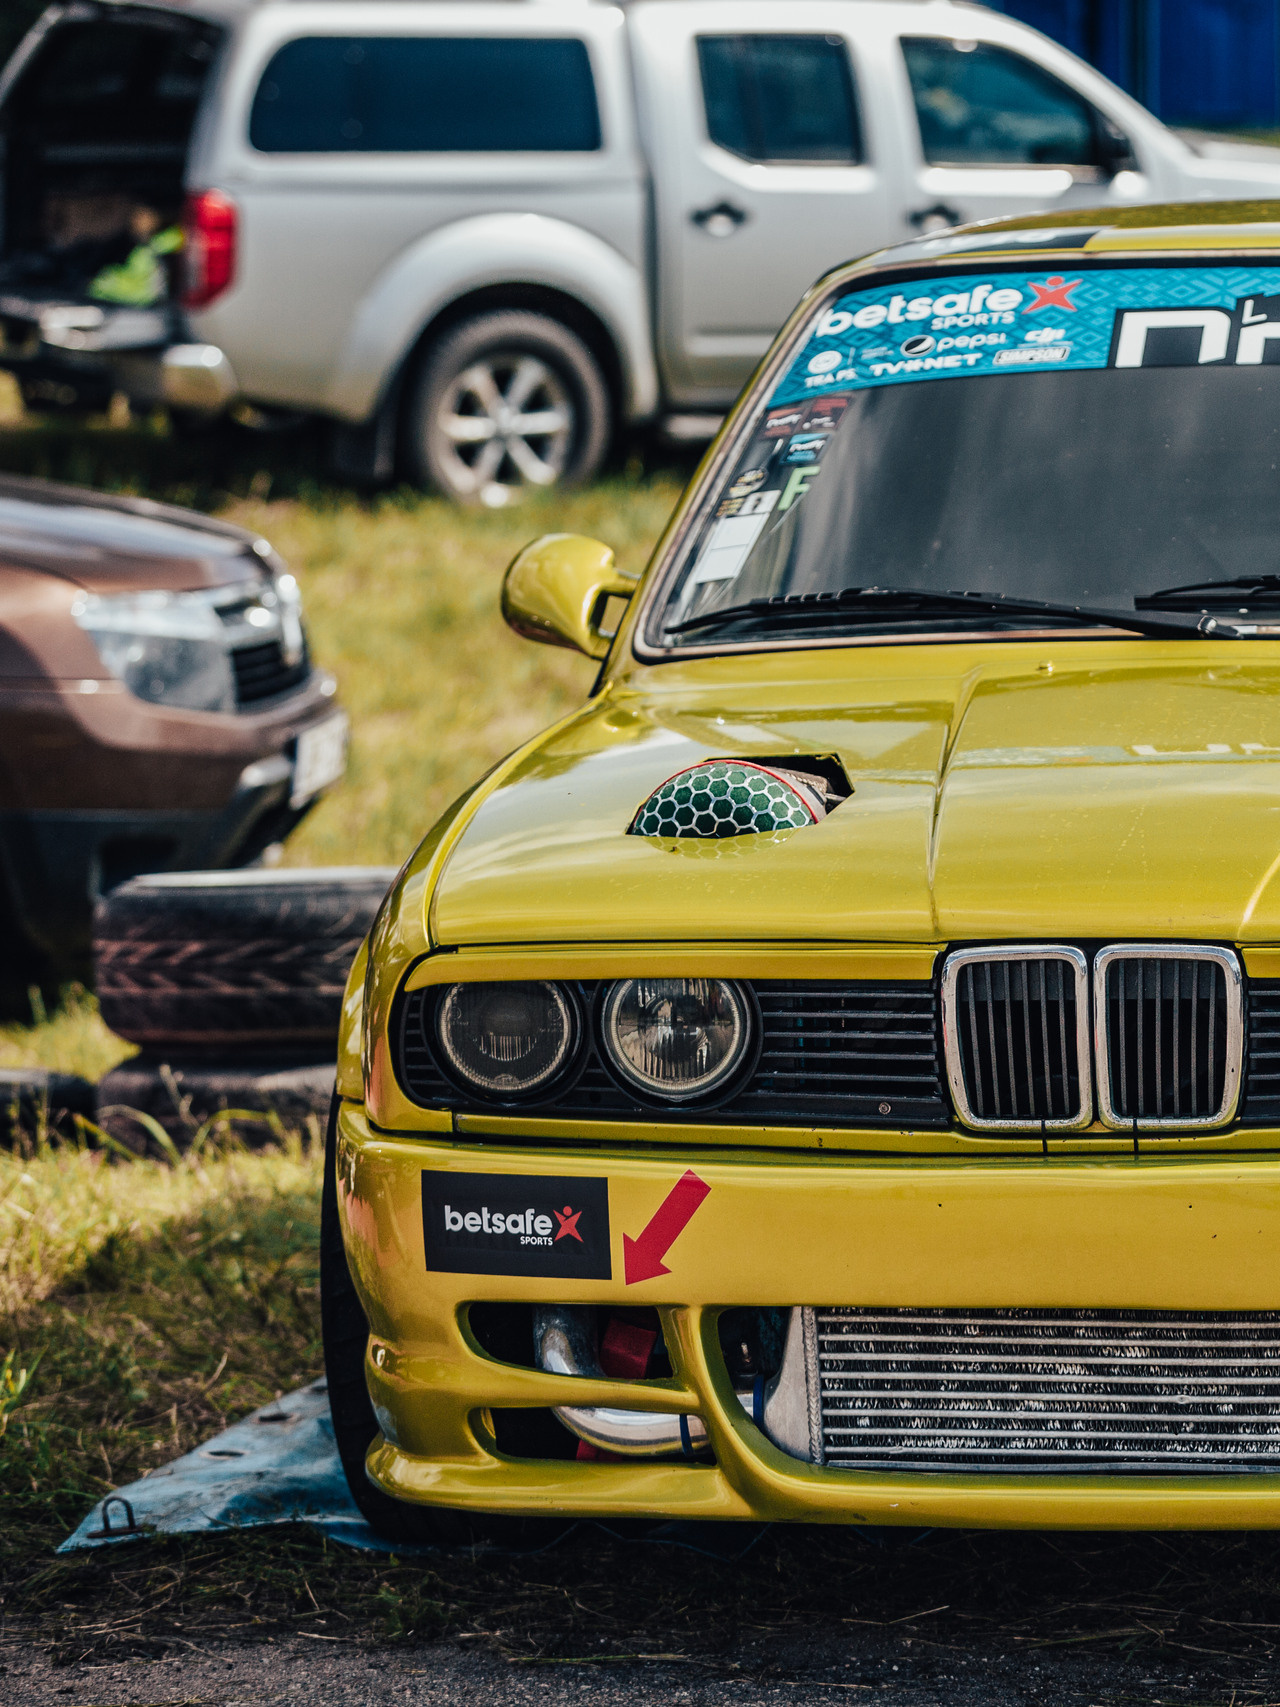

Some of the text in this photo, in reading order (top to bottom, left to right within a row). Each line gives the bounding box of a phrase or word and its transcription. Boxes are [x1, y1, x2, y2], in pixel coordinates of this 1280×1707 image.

[815, 284, 1023, 338] betsafe
[931, 310, 1016, 331] SPORTS
[936, 332, 1007, 353] pepsi
[444, 1204, 553, 1236] betsafe
[520, 1235, 553, 1246] SPORTS
